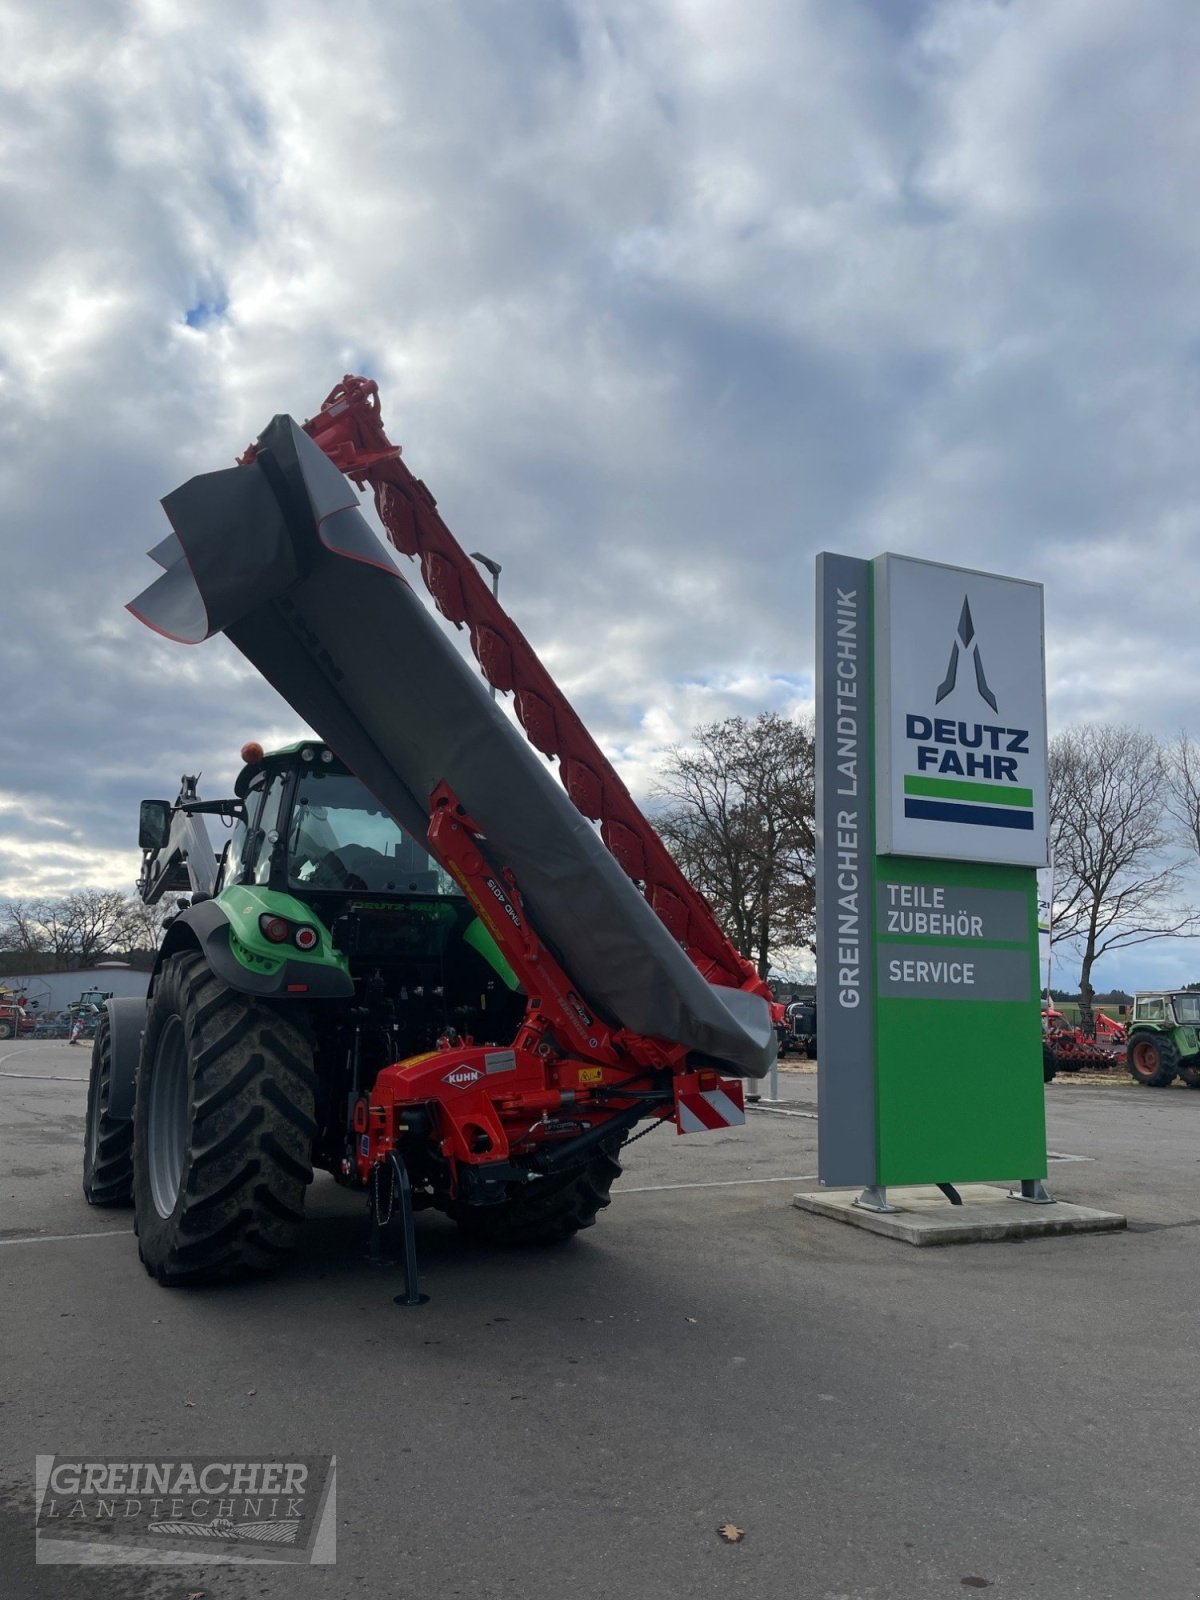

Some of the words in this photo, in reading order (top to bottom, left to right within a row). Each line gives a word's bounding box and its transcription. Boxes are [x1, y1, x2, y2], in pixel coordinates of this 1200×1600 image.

[836, 587, 858, 797] LANDTECHNIK
[906, 713, 1029, 754] DEUTZ
[917, 745, 1018, 782] FAHR
[486, 878, 506, 903] 4015
[886, 884, 945, 909] TEILE
[838, 810, 860, 1009] GREINACHER
[887, 909, 983, 937] ZUBEHÖR
[888, 959, 976, 985] SERVICE
[447, 1071, 479, 1084] KUHN
